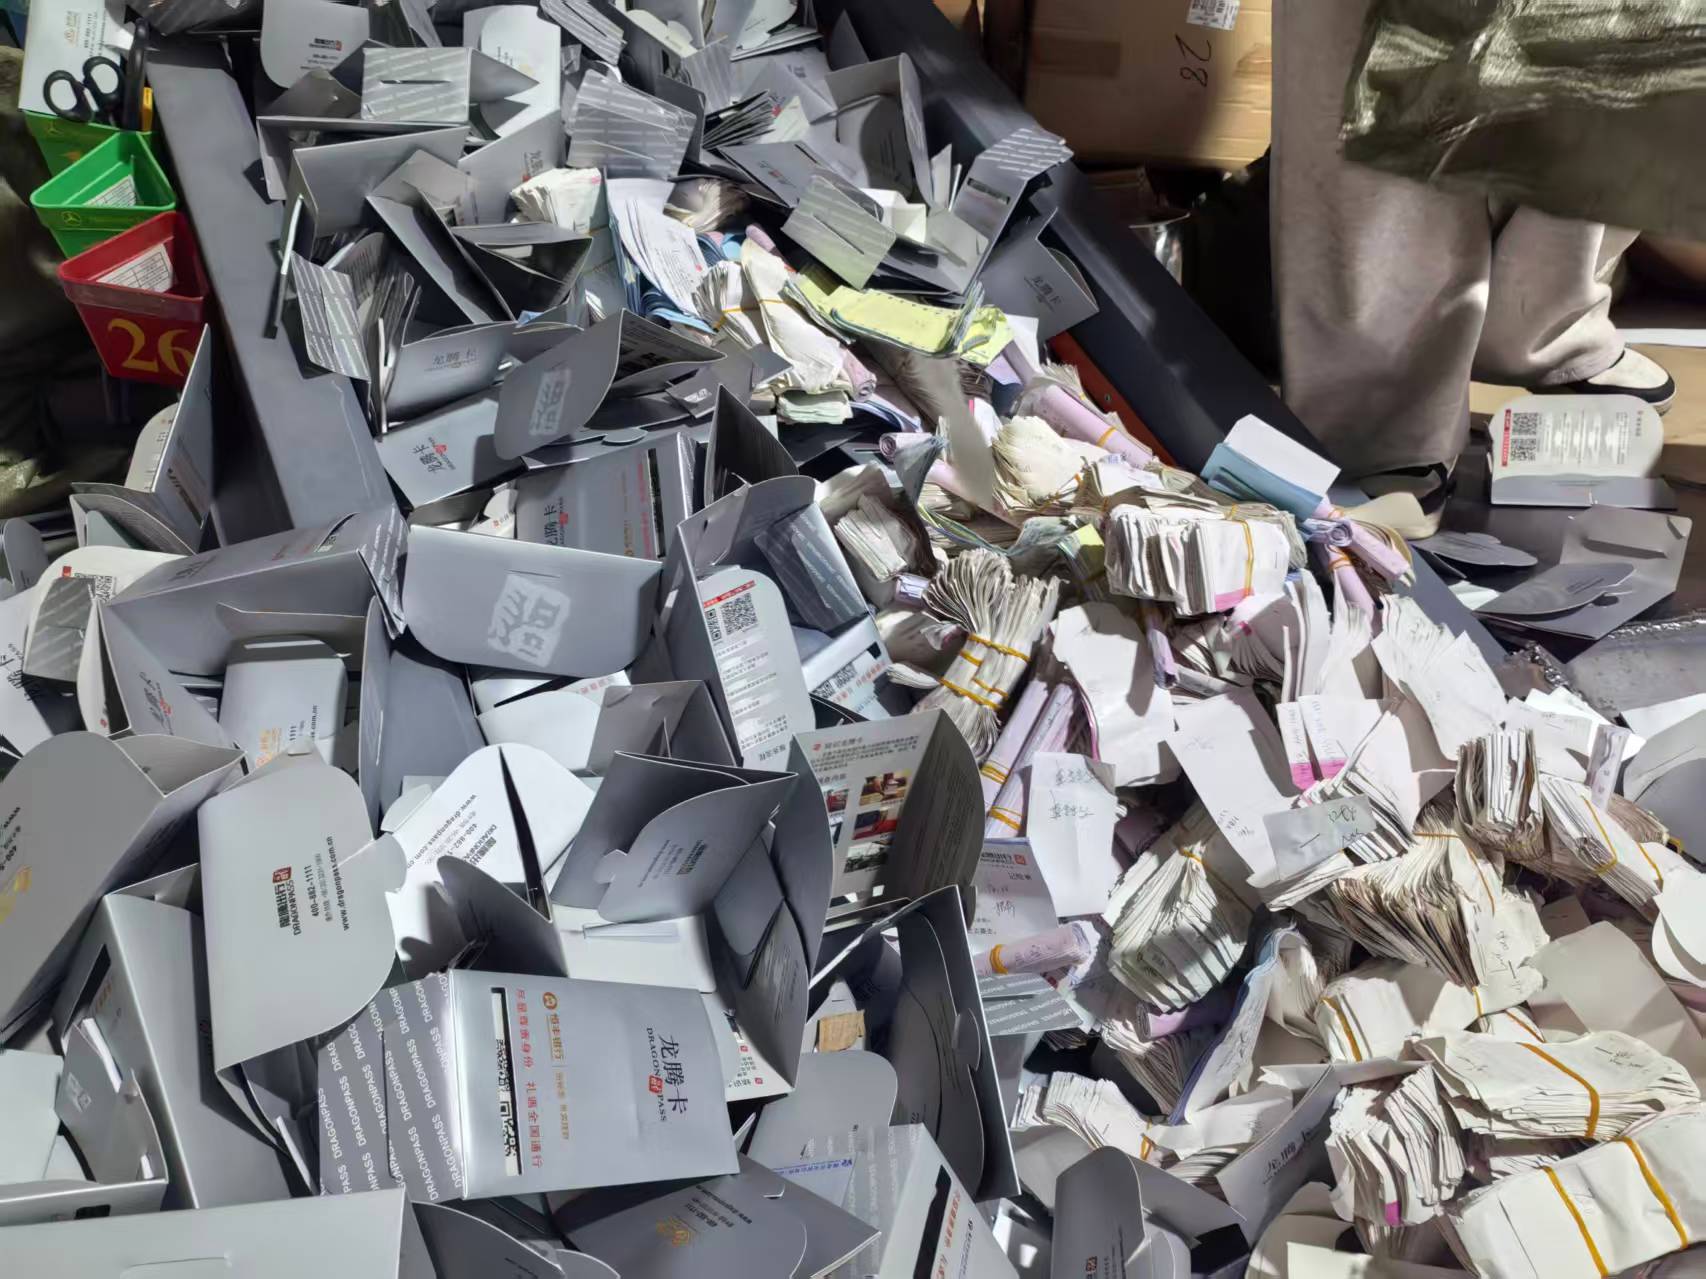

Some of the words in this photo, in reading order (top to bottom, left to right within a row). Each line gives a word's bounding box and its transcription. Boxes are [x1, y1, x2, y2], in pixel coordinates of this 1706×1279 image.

[107, 318, 196, 377] 26
[286, 879, 302, 936] DRAGONPASS
[304, 864, 319, 917] 400-882-1111
[326, 835, 349, 931] www.dragonpass.com.cn
[384, 1050, 413, 1121] DRAGONPASS
[406, 1038, 437, 1109] DRAGONPASS
[645, 1027, 661, 1077] DRAGON
[656, 1094, 668, 1123] PASS
[658, 1034, 689, 1115] 龙腾卡
[339, 1075, 367, 1147] DRAGONPASS
[525, 1081, 543, 1169] 礼遇全国通行
[407, 1126, 439, 1201] DRAGONPASS
[431, 1113, 463, 1189] DRAGONPASS
